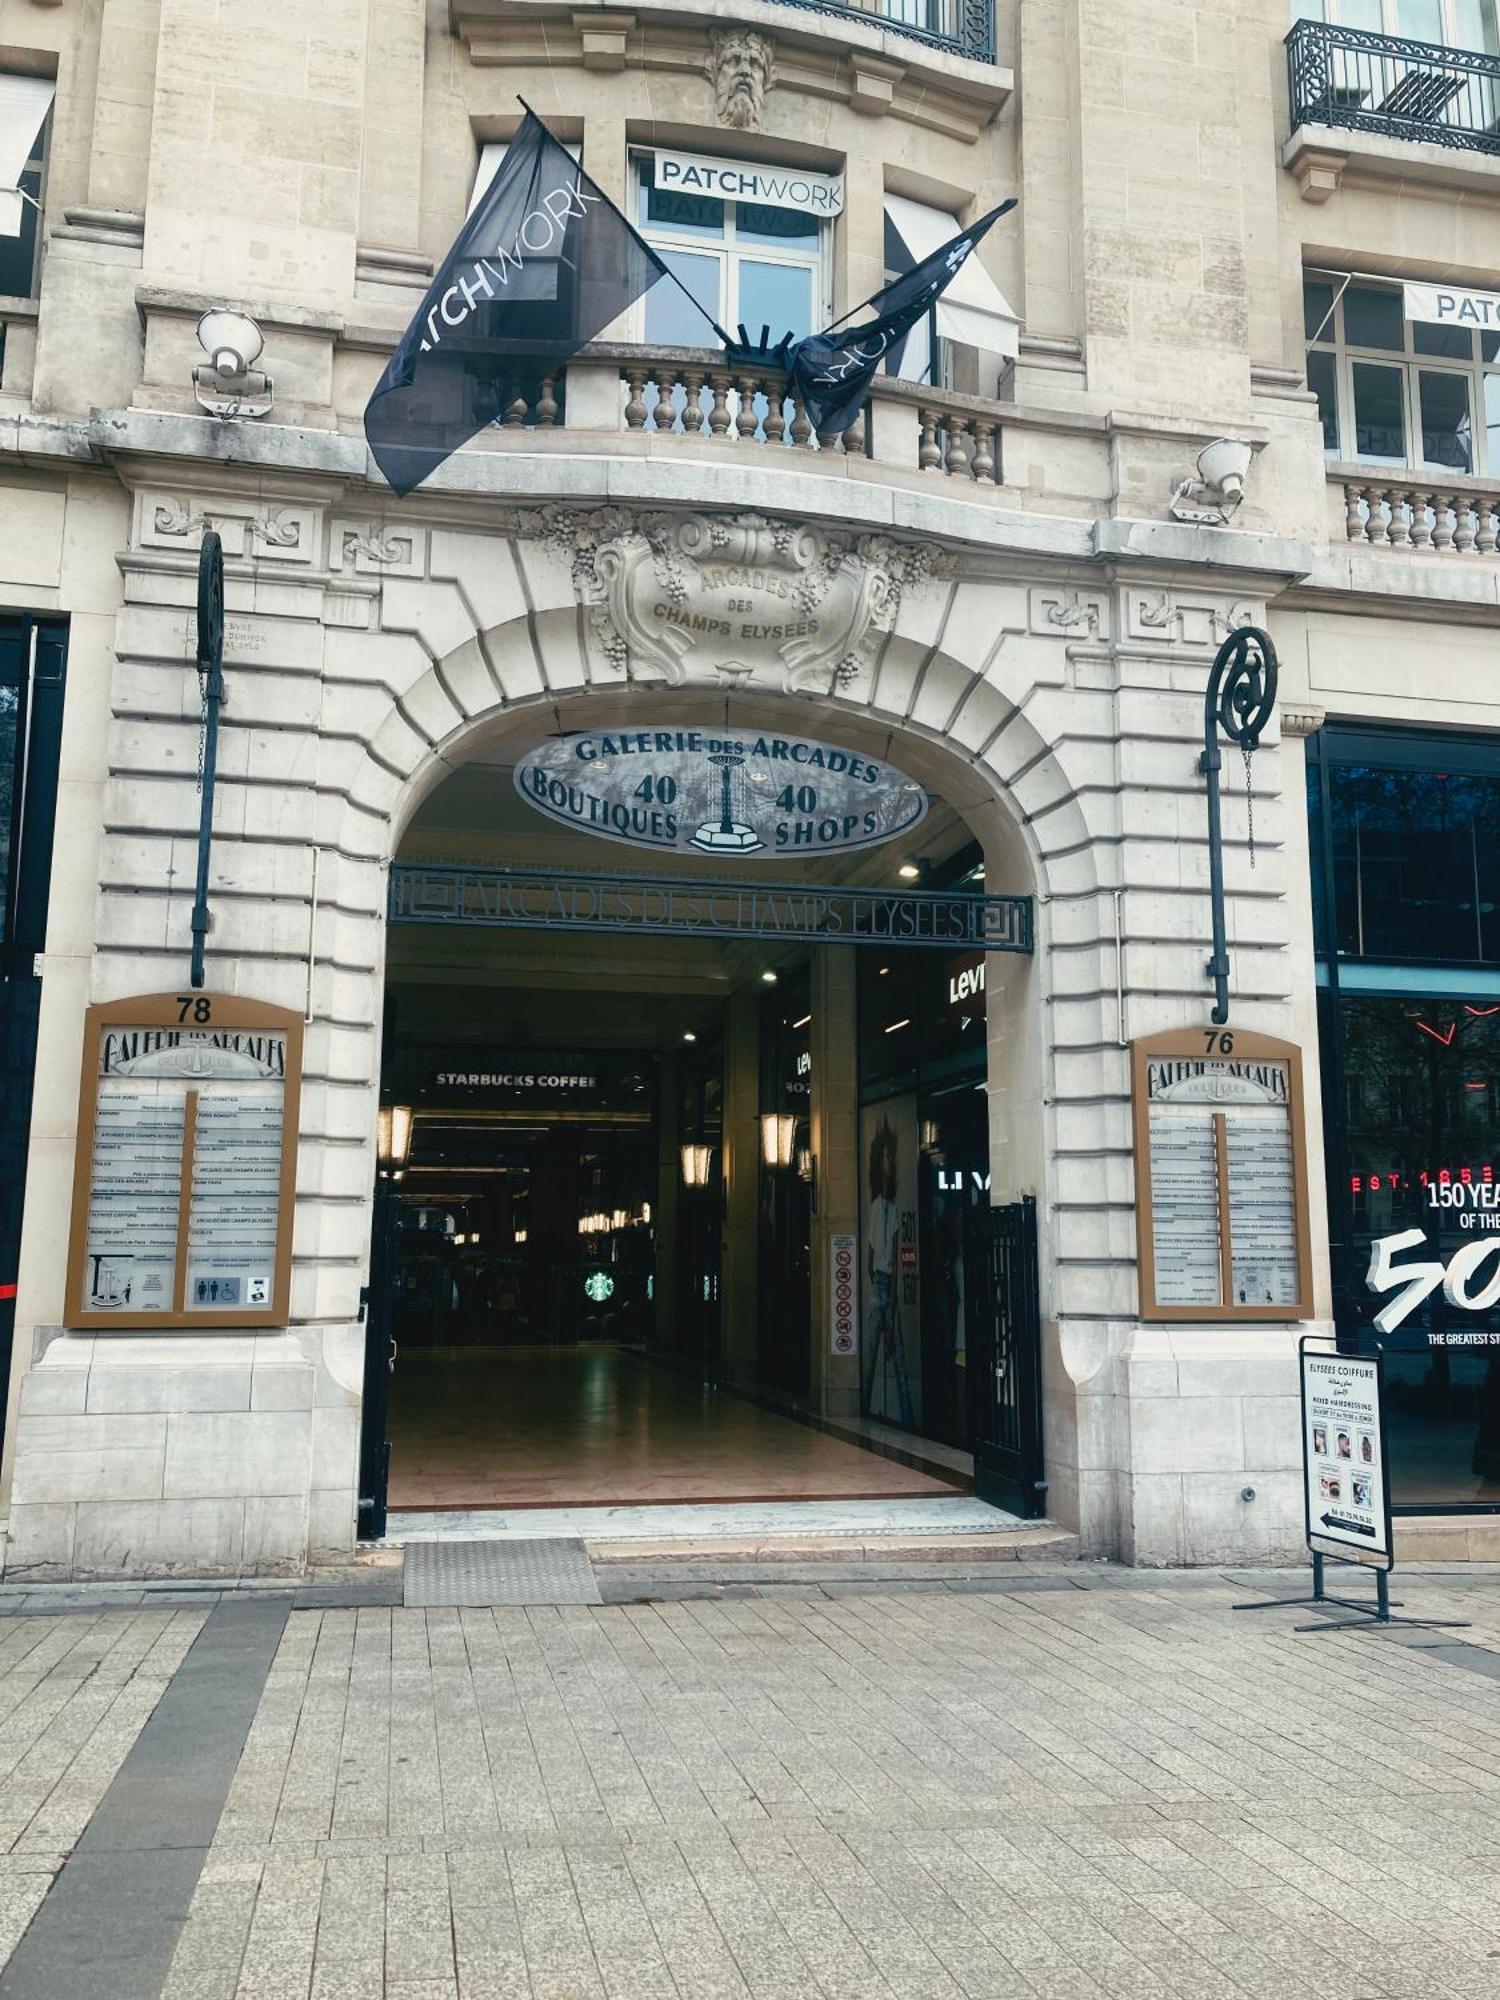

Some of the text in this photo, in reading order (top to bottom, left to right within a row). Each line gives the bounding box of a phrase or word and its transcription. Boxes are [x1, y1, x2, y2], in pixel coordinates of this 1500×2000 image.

[662, 161, 842, 209] PATCHWORK
[701, 565, 789, 599] ARCADES
[728, 599, 753, 613] DES
[654, 602, 819, 640] CHAMPS ELYSEES
[575, 732, 880, 784] GALERIE DES ARCADES
[532, 766, 678, 840] BOUTIQUES
[634, 774, 677, 805] 40
[775, 784, 817, 814] 40
[775, 810, 877, 846] SHOPS
[464, 875, 965, 939] ARCADES DES CHAMPS ELYSEES
[176, 996, 211, 1024] 78
[1204, 1031, 1234, 1055] 76
[436, 1073, 597, 1088] STARBUCKS COFFEE
[1351, 1174, 1409, 1192] EST.
[1428, 1182, 1465, 1208] 150
[1460, 1213, 1500, 1229] OF THE
[1427, 1333, 1446, 1345] THE
[1446, 1333, 1488, 1345] GREATEST
[1338, 1366, 1375, 1379] COIFFURE
